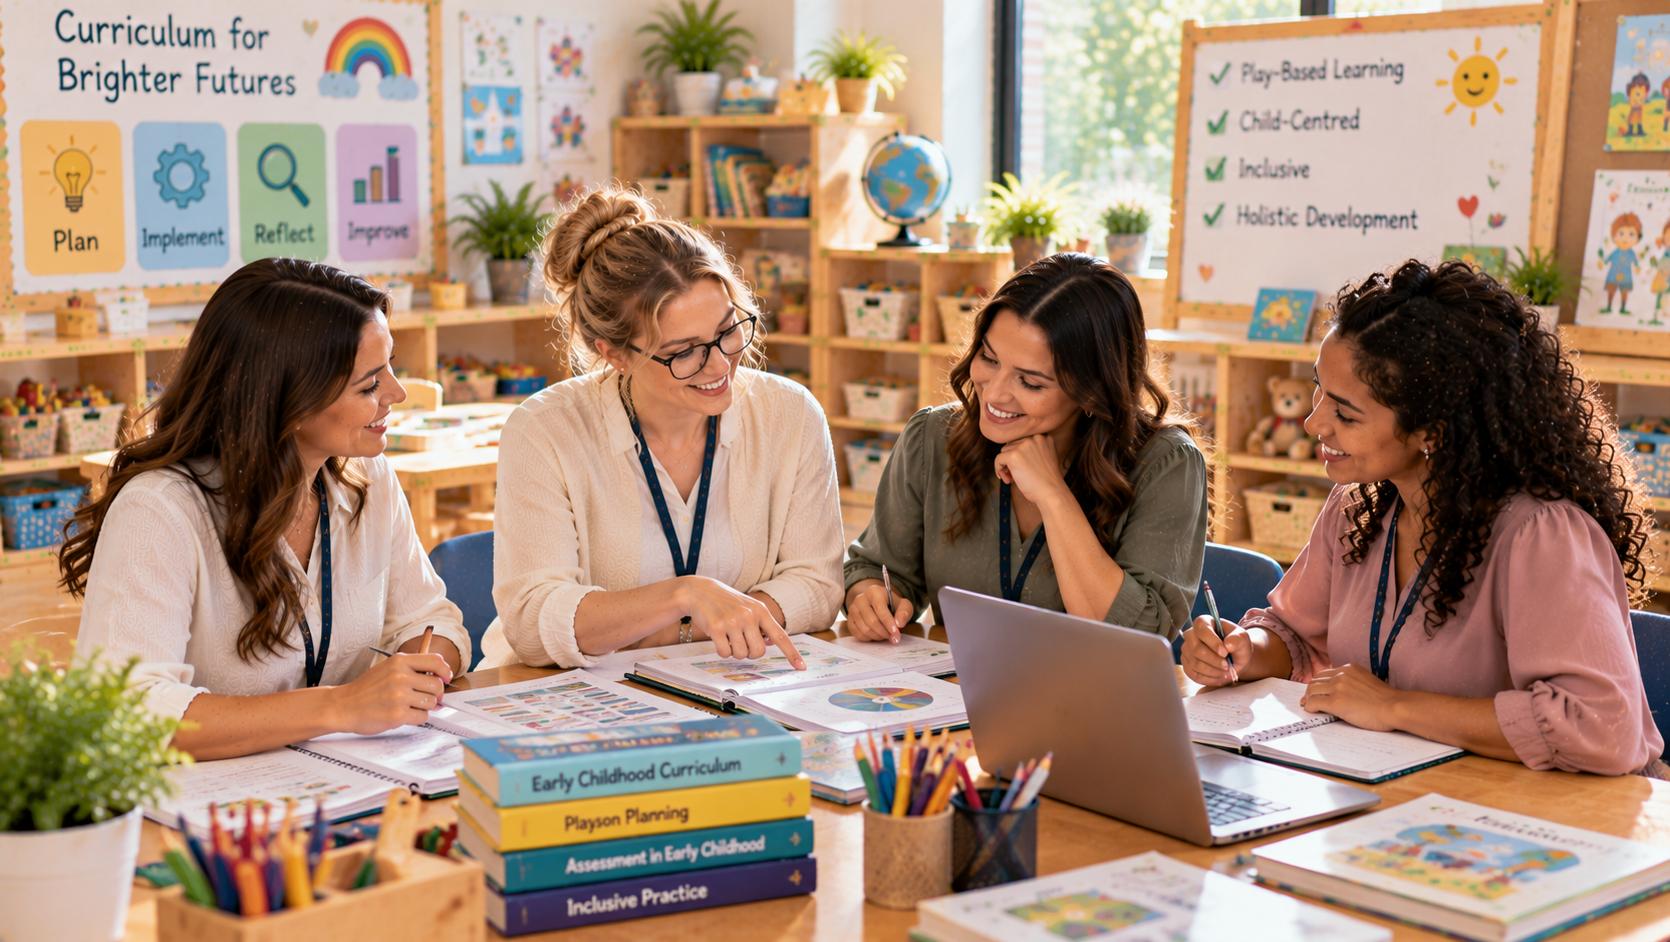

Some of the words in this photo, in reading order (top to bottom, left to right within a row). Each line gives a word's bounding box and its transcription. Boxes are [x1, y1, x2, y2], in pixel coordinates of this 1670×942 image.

[55, 9, 216, 49] Curriculum
[229, 16, 270, 50] for
[58, 58, 182, 103] Brighter
[196, 62, 296, 96] Futures
[1241, 58, 1327, 88] Play-Based
[1334, 58, 1404, 85] Learning
[1239, 107, 1360, 132] Child-Centred
[1238, 157, 1311, 179] Inclusive
[255, 222, 315, 245] Reflect
[347, 221, 410, 245] Improve
[1236, 205, 1299, 228] Holistic
[1306, 206, 1419, 235] Development
[53, 229, 99, 253] Plan
[142, 227, 226, 254] Implement
[532, 770, 574, 793] Early
[578, 764, 655, 788] Childhood
[660, 756, 742, 779] Curriculum
[564, 812, 621, 832] Playson
[625, 805, 690, 825] Planning
[565, 851, 648, 875] Assessment
[650, 849, 663, 865] in
[664, 844, 699, 863] Early
[701, 834, 766, 859] Childhood
[567, 894, 638, 917] Inclusive
[641, 883, 708, 907] Practice
